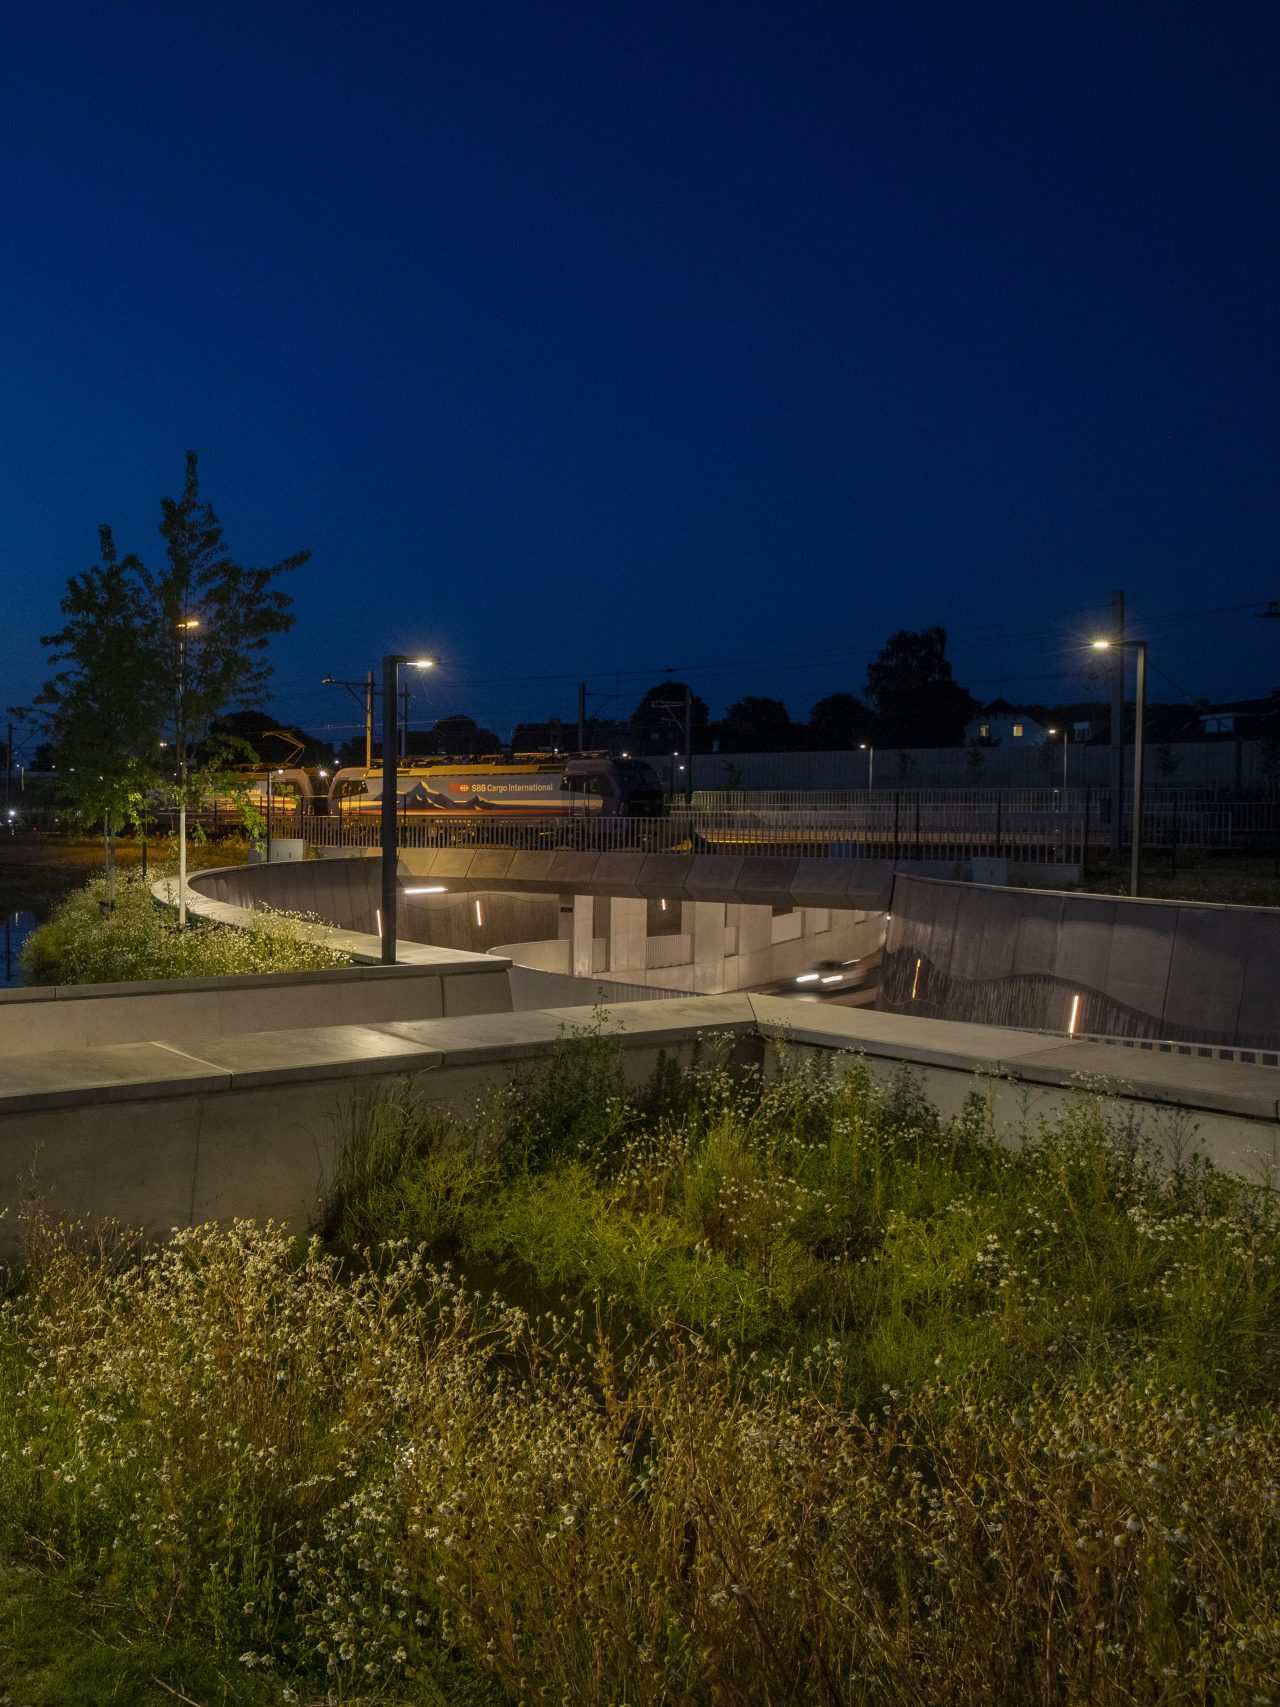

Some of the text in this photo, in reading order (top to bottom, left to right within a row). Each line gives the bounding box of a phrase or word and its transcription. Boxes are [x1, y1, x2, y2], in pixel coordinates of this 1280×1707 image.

[471, 783, 553, 793] SBB Cargo International
